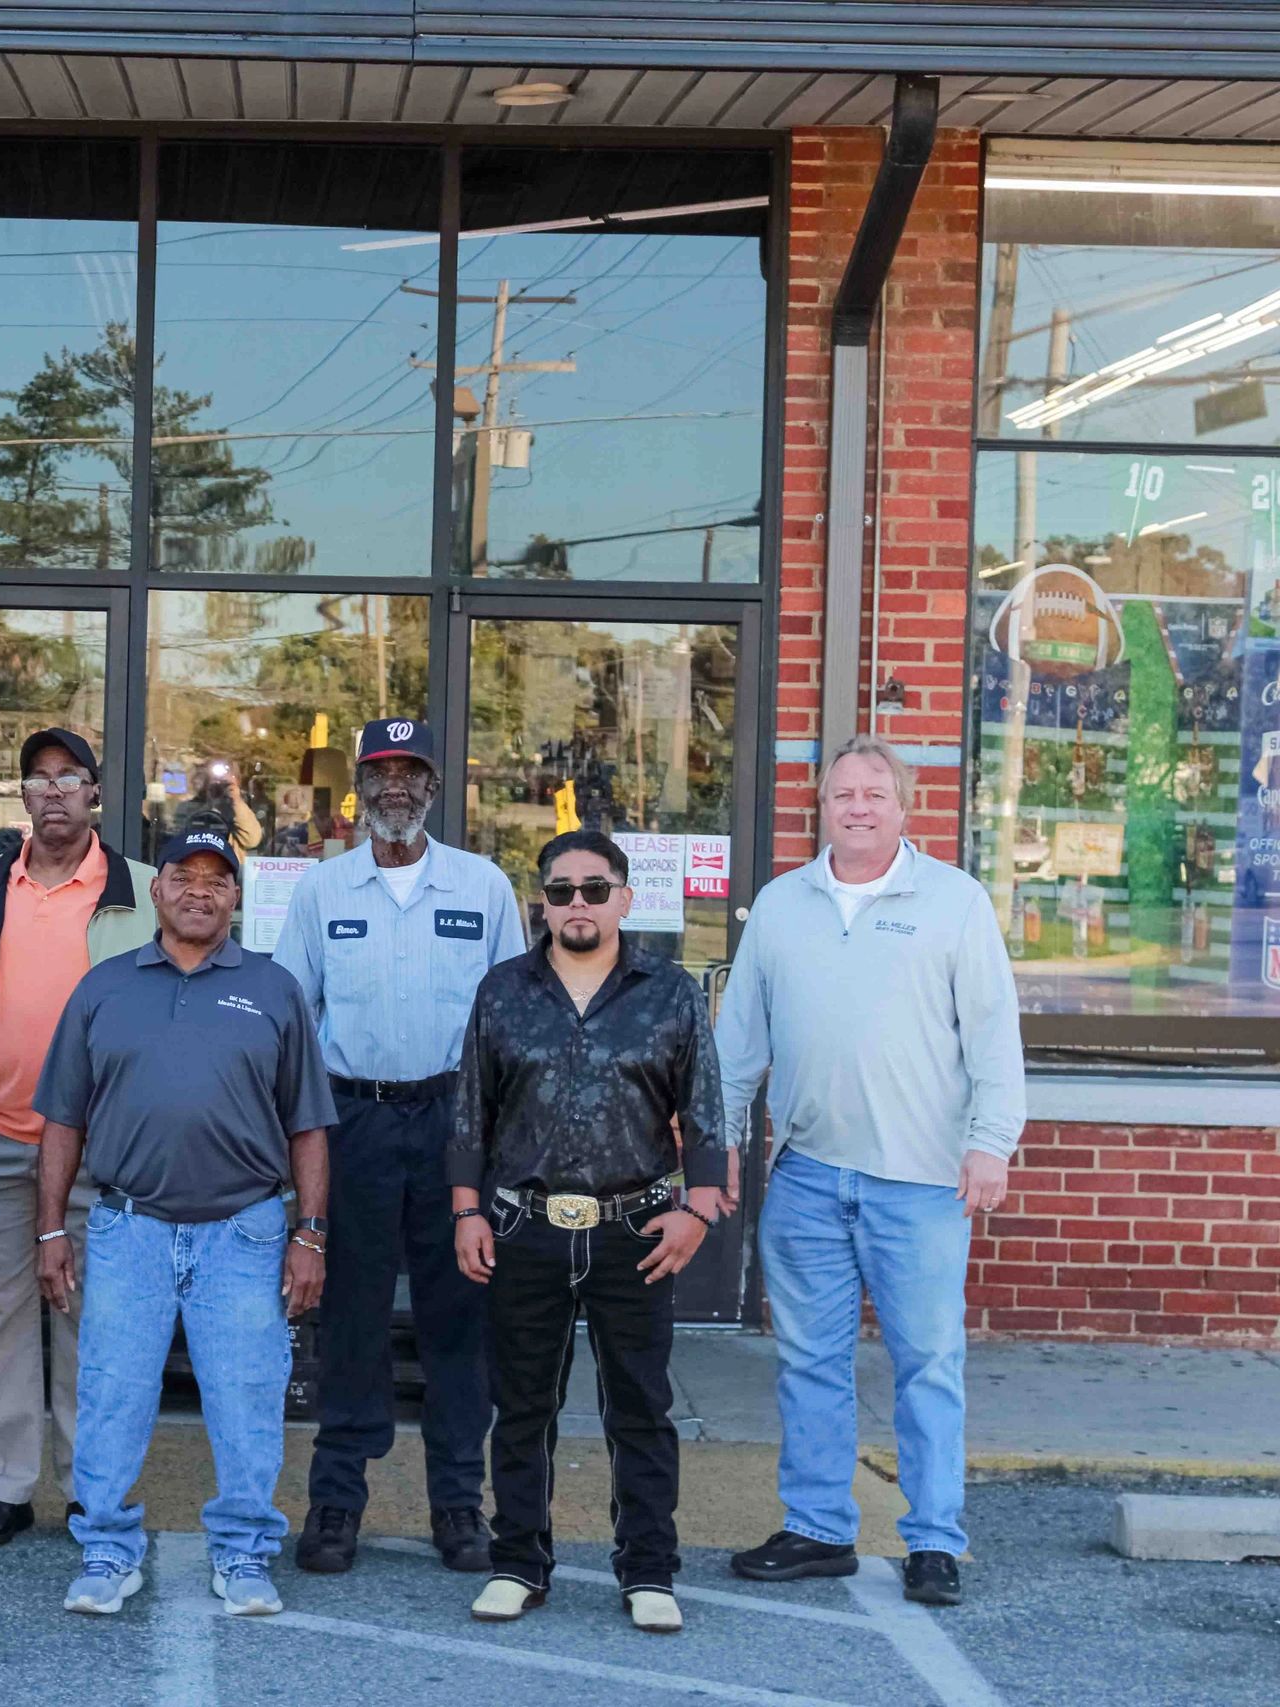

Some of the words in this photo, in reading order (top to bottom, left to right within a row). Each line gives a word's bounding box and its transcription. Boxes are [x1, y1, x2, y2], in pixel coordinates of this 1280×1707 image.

[1124, 462, 1164, 501] 10
[1252, 474, 1280, 511] 2
[386, 721, 414, 743] W
[614, 836, 680, 853] PLEASE
[253, 861, 311, 872] HOURS
[631, 857, 678, 872] BACKPACKS
[645, 877, 673, 888] PETS
[689, 877, 724, 893] PULL
